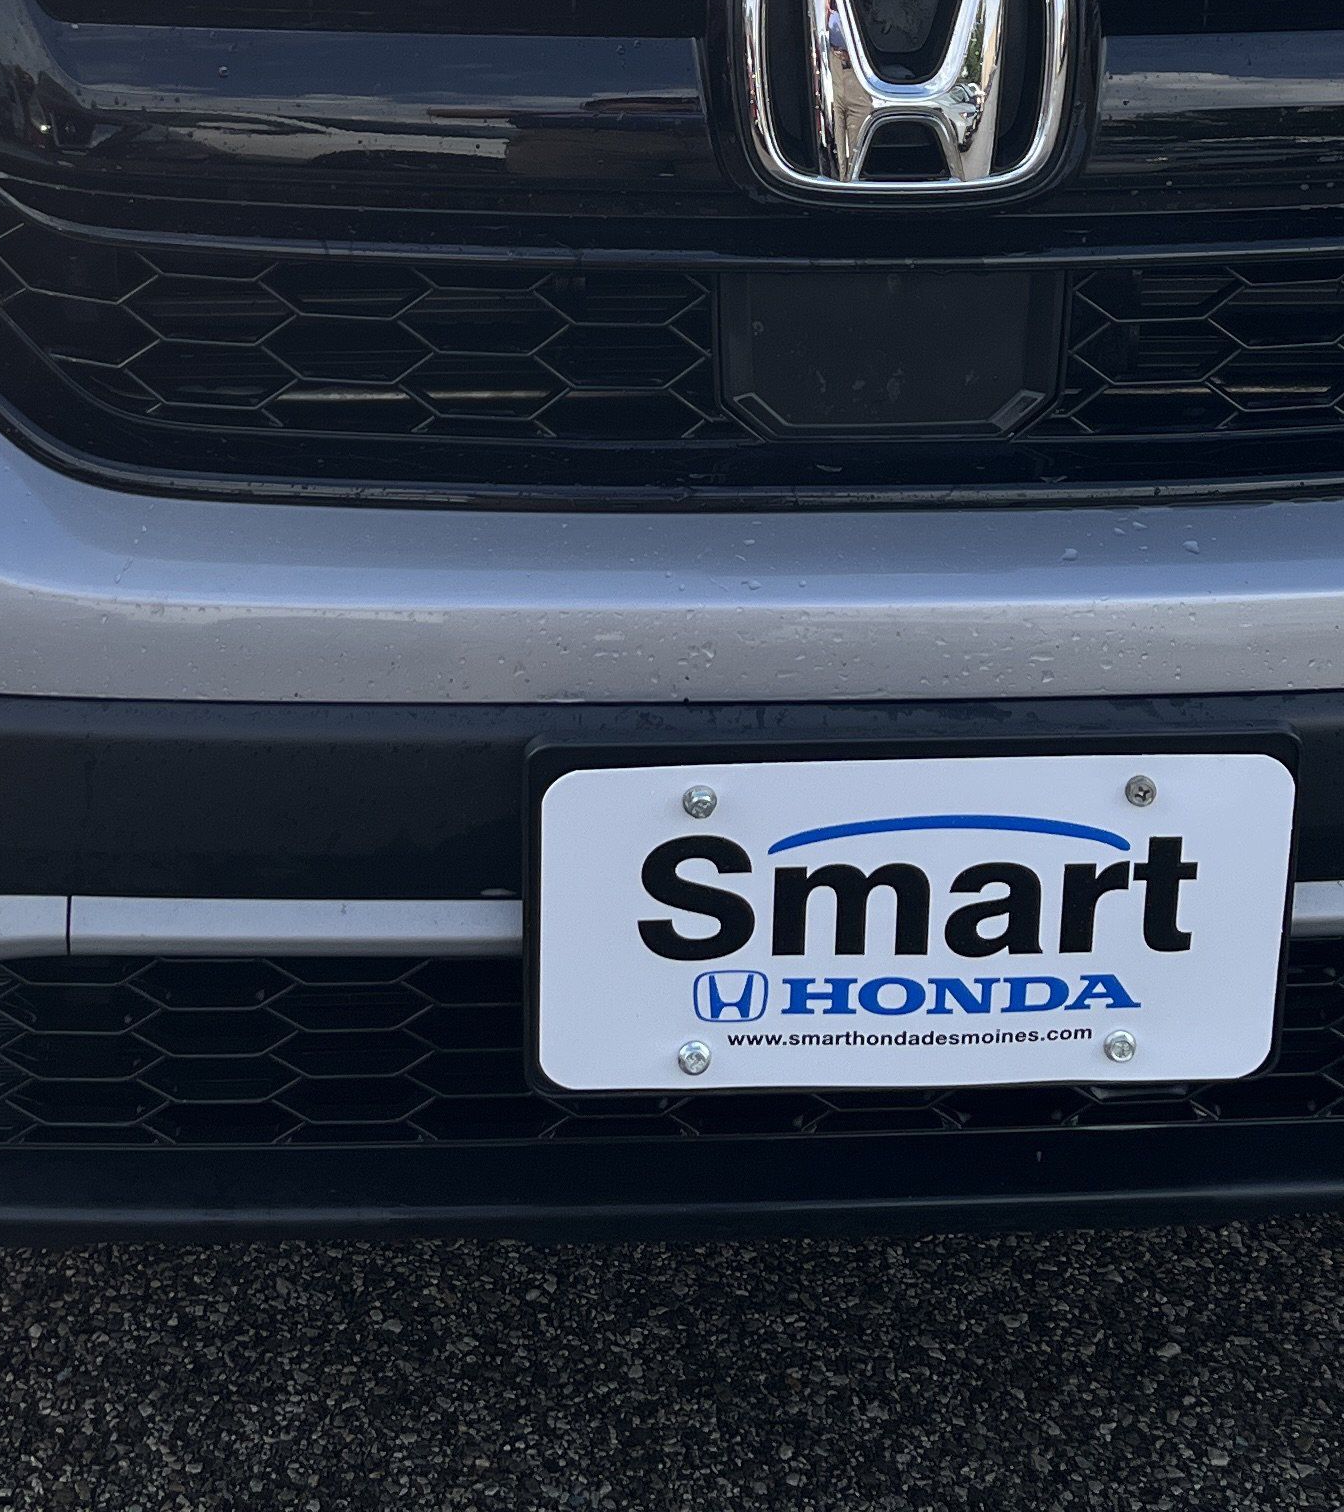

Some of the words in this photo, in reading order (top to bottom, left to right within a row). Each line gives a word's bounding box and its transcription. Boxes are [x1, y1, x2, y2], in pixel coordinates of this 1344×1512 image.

[637, 835, 1198, 961] Smart
[779, 971, 1144, 1017] HONDA
[727, 1027, 1092, 1047] www.smarthondadesmoines.com
